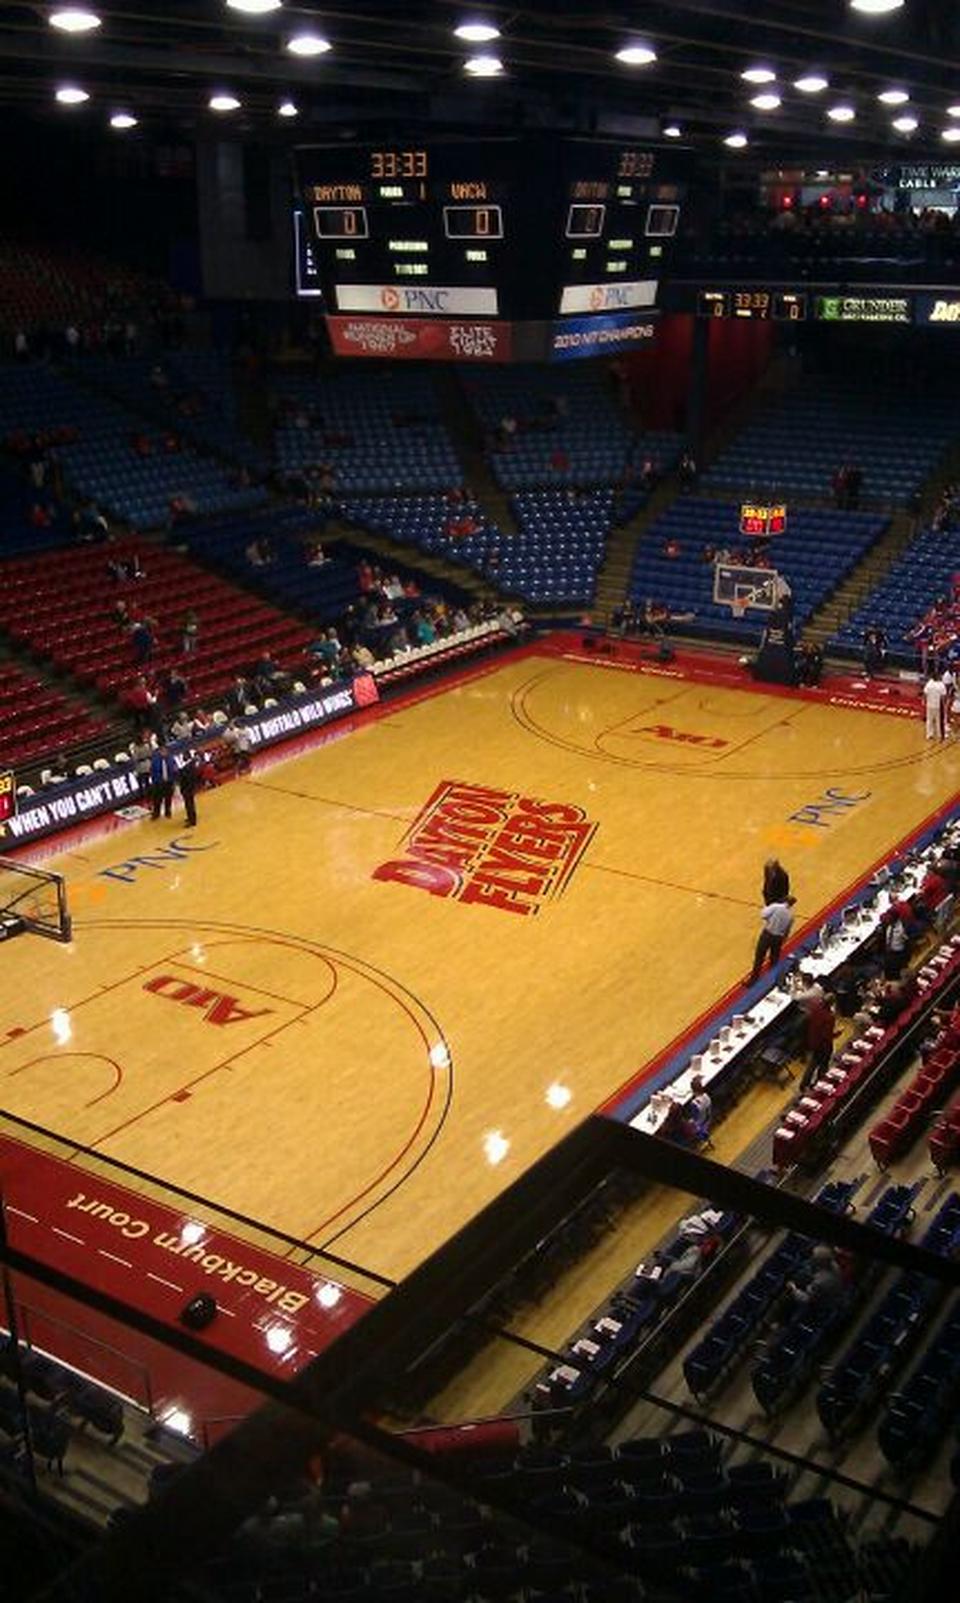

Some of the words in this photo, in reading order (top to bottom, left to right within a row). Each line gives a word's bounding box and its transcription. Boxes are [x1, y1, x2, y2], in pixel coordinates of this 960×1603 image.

[370, 152, 427, 178] 33:33
[344, 210, 356, 235] 0
[476, 210, 490, 235] 0
[403, 290, 448, 312] PNC
[602, 286, 632, 305] PNC
[8, 806, 50, 837] WHEN
[48, 794, 78, 820] YOU
[76, 779, 114, 812] CAN'T
[112, 775, 134, 798] BE
[787, 787, 872, 827] PNC
[98, 834, 220, 883] PNC
[371, 783, 517, 898] DAYTON
[456, 798, 587, 916] FLYERS
[67, 1192, 150, 1238] Court
